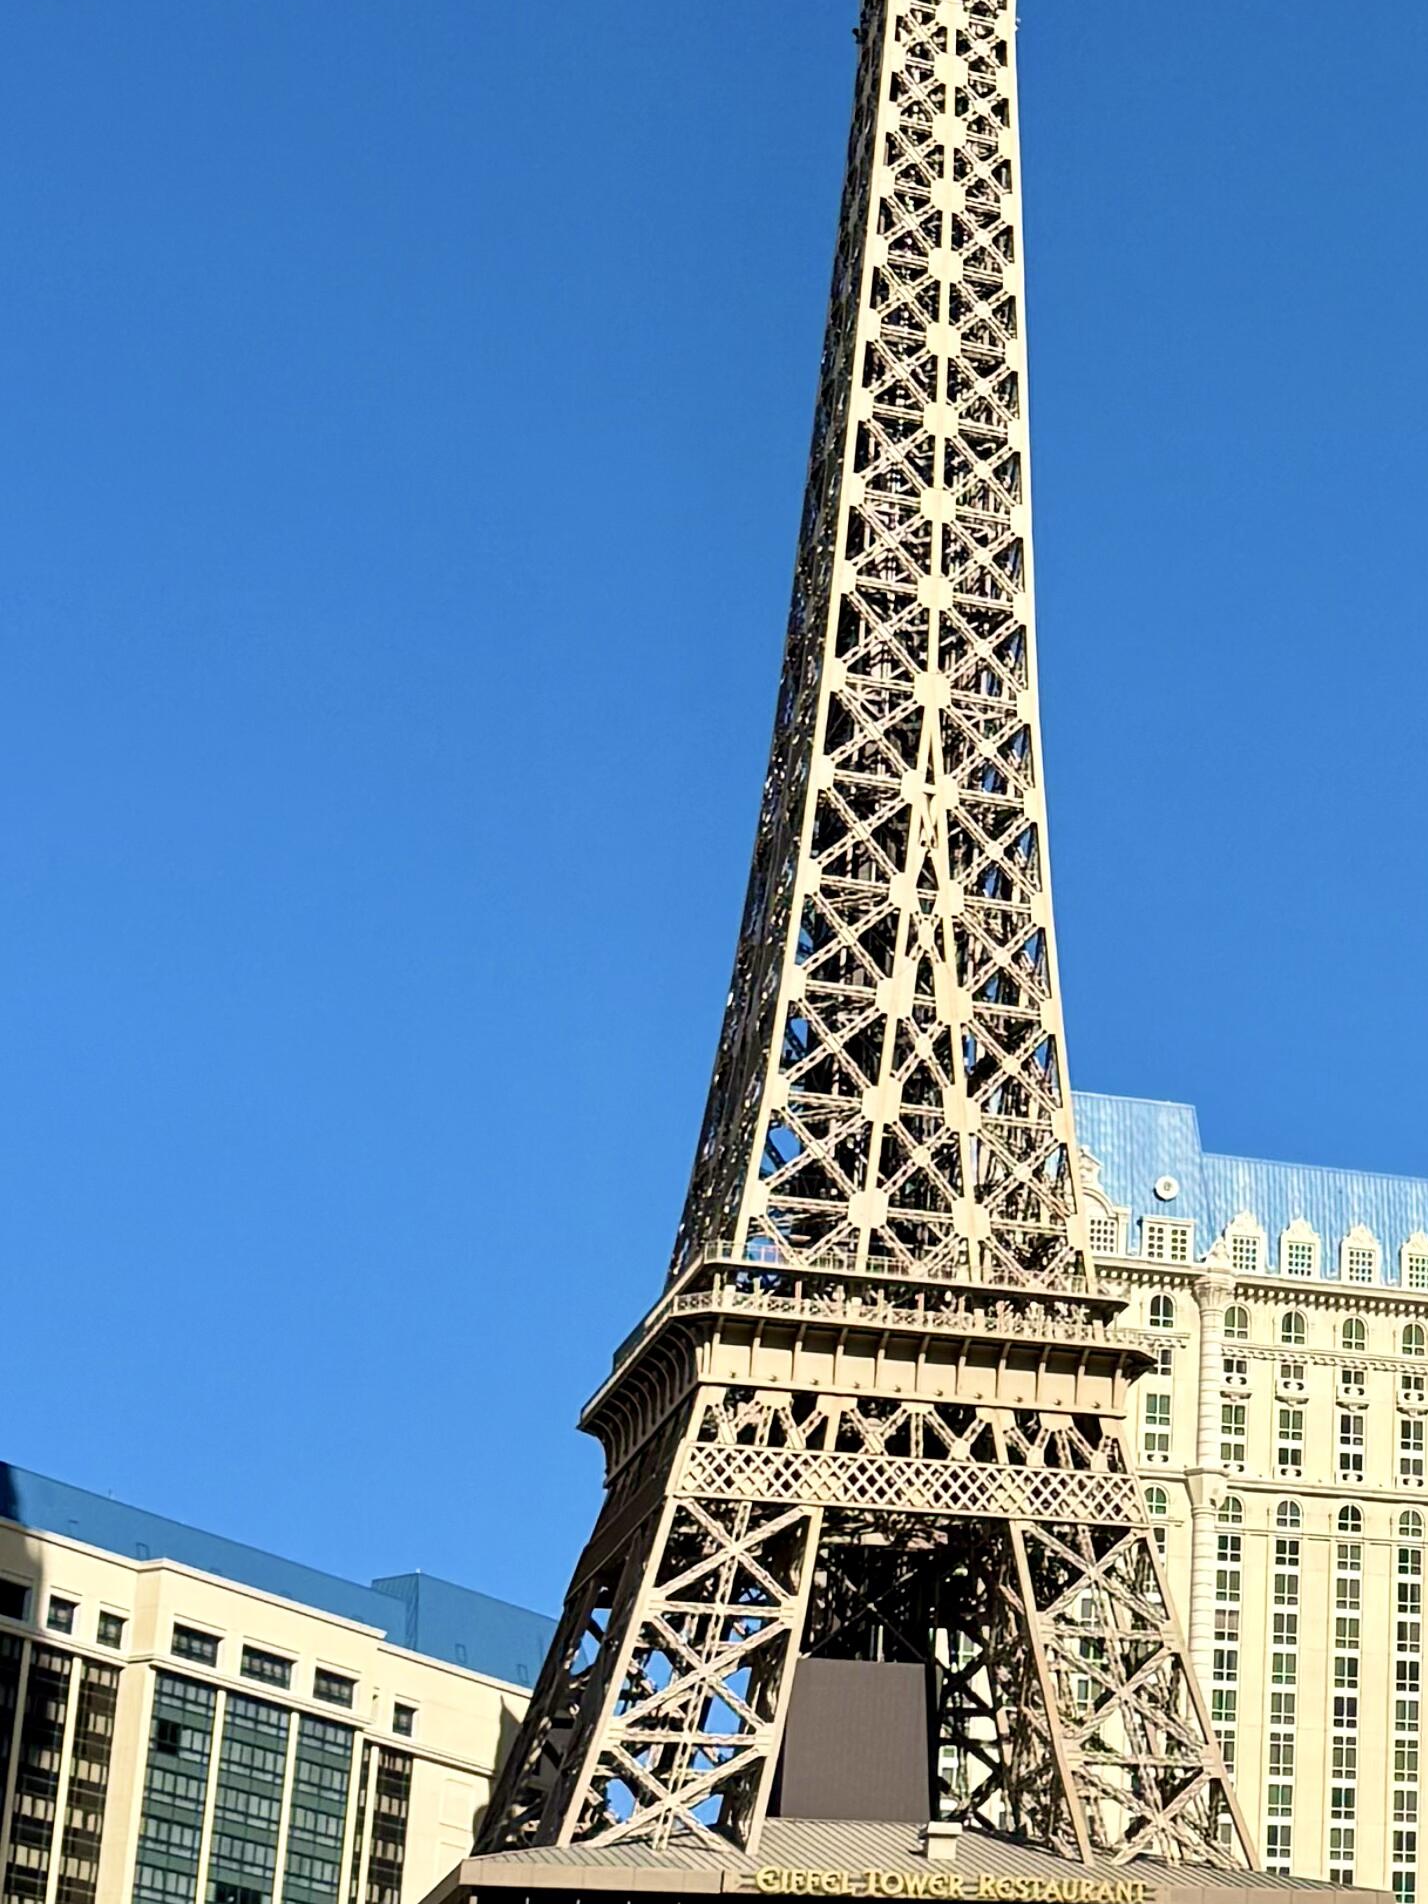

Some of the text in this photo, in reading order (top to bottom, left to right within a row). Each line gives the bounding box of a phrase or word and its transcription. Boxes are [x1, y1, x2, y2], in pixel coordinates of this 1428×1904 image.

[757, 1868, 1151, 1904] EIFFEL TOWER RESTAURANT
